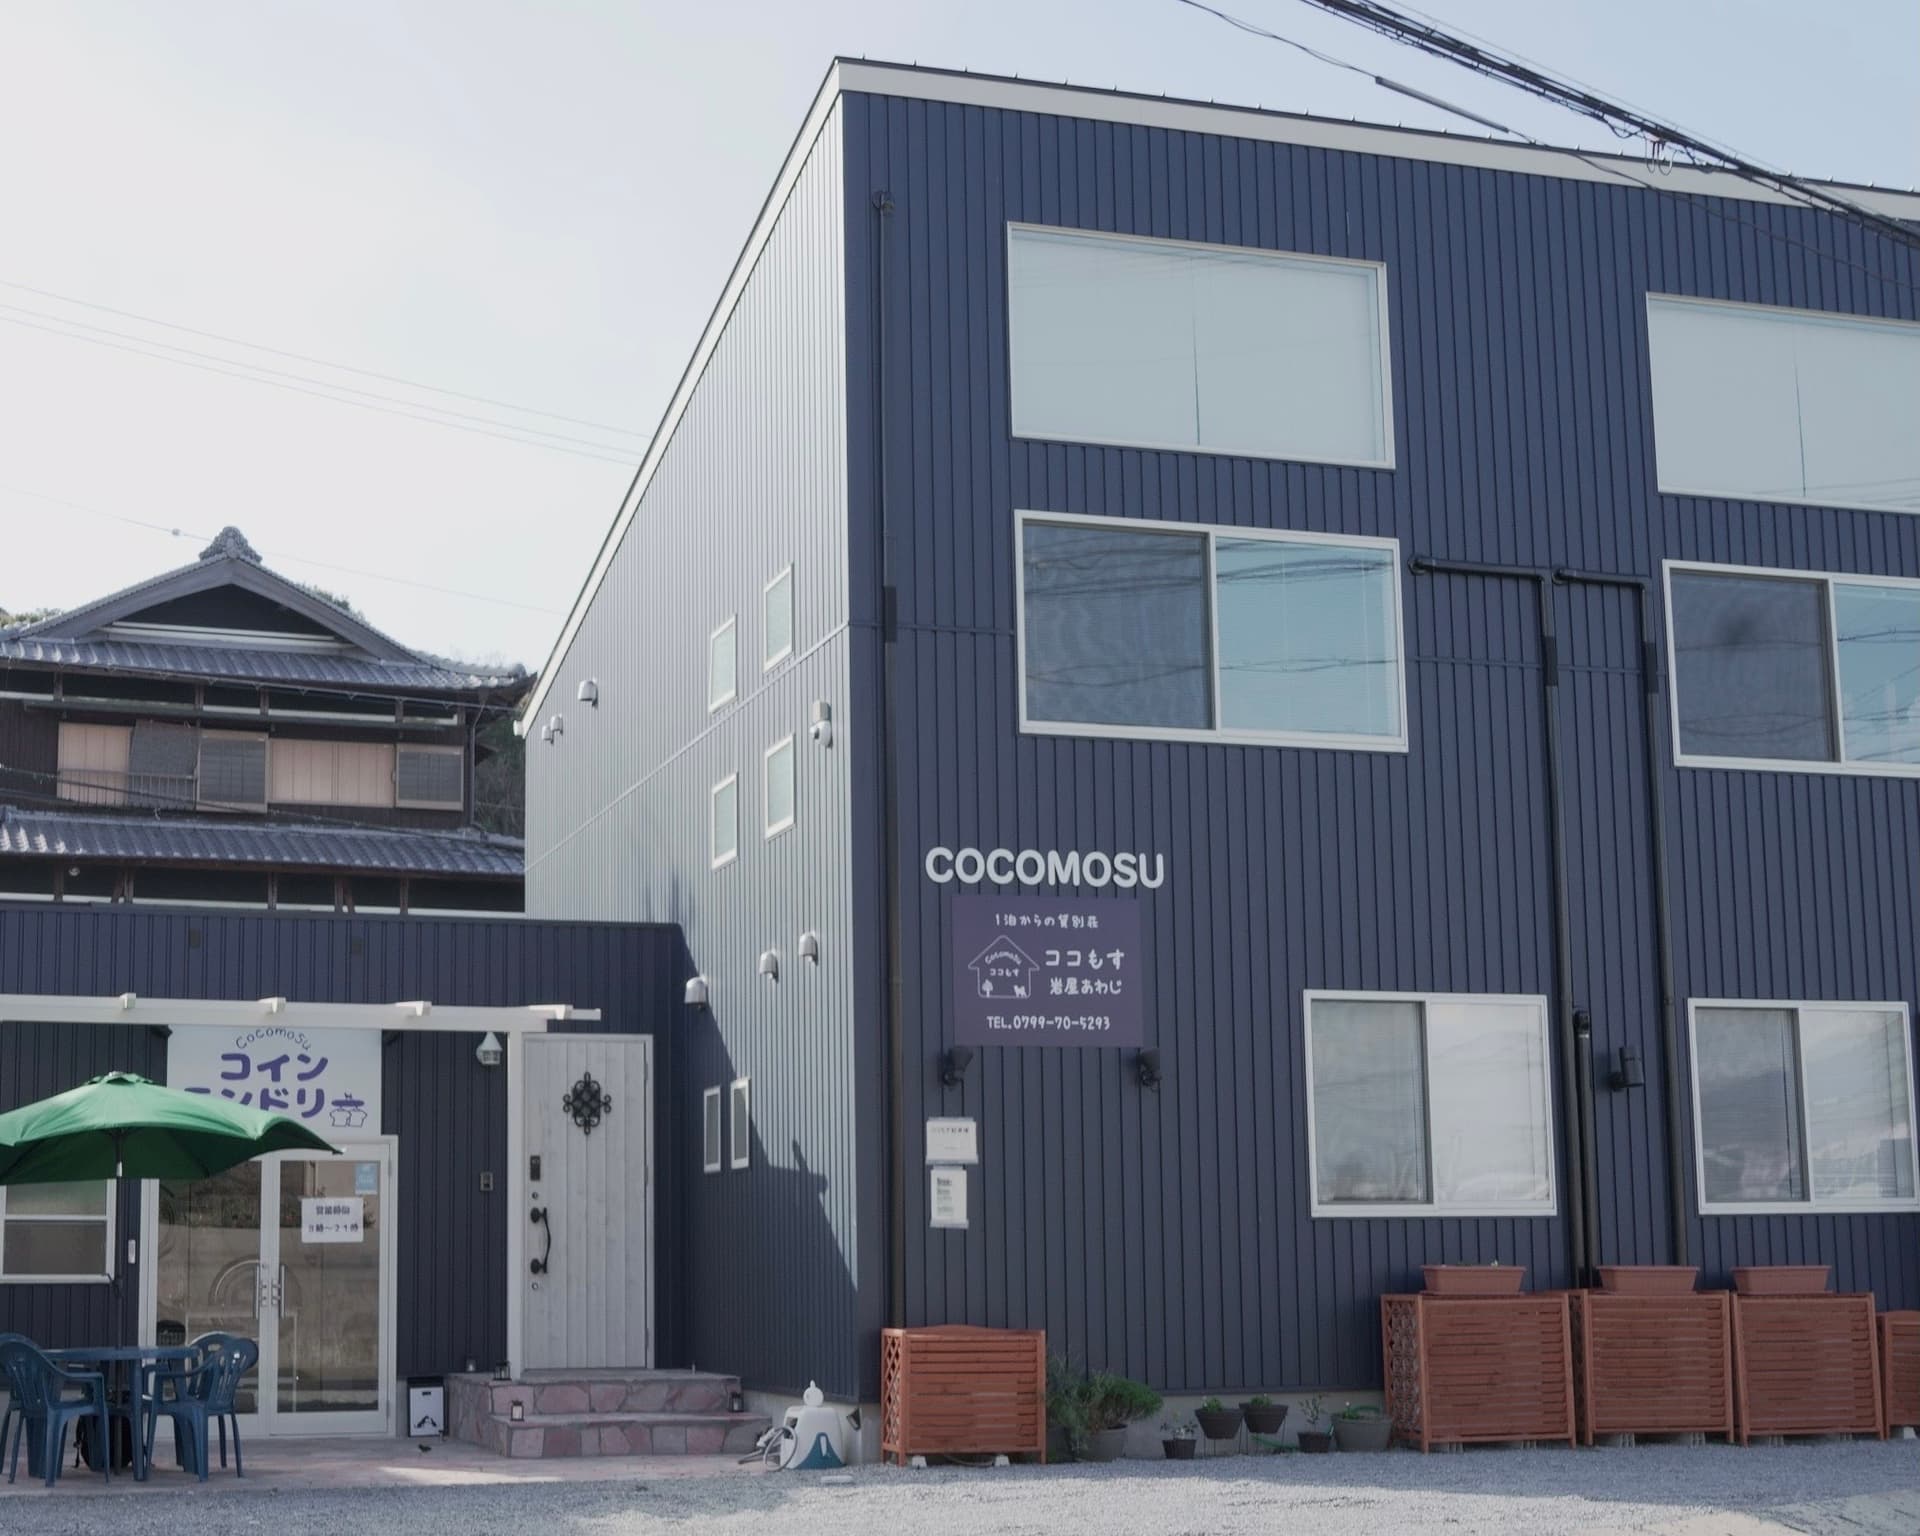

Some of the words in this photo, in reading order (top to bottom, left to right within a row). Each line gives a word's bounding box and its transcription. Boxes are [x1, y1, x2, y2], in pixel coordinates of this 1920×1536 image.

[925, 847, 1164, 888] COCOMOSU
[1045, 949, 1125, 970] ココもす
[1050, 977, 1122, 995] 岩屋あわじ
[986, 1015, 1111, 1030] TEL.0799-70-5293
[221, 1053, 328, 1082] コイン
